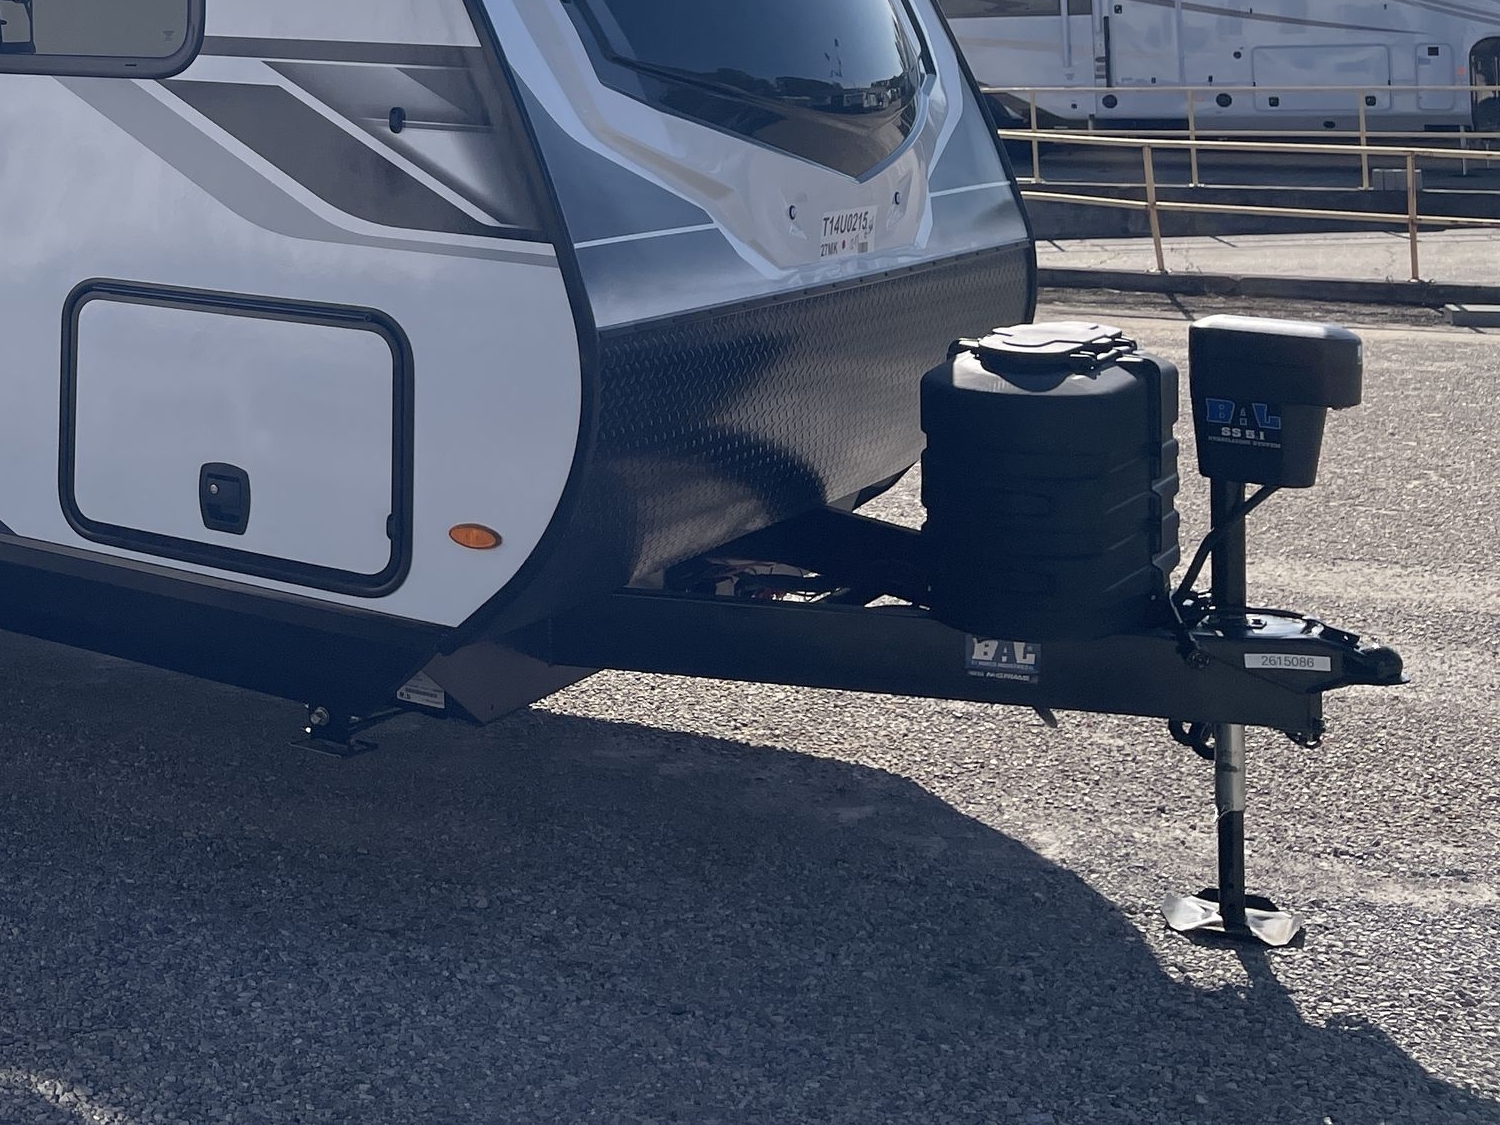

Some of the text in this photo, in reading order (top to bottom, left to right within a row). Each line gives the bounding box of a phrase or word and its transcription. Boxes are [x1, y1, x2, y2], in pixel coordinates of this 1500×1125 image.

[823, 211, 869, 237] T14U0215
[1205, 397, 1281, 430] BAL
[1221, 426, 1242, 438] SS
[971, 637, 1036, 665] BAL
[1260, 655, 1315, 668] 2615086
